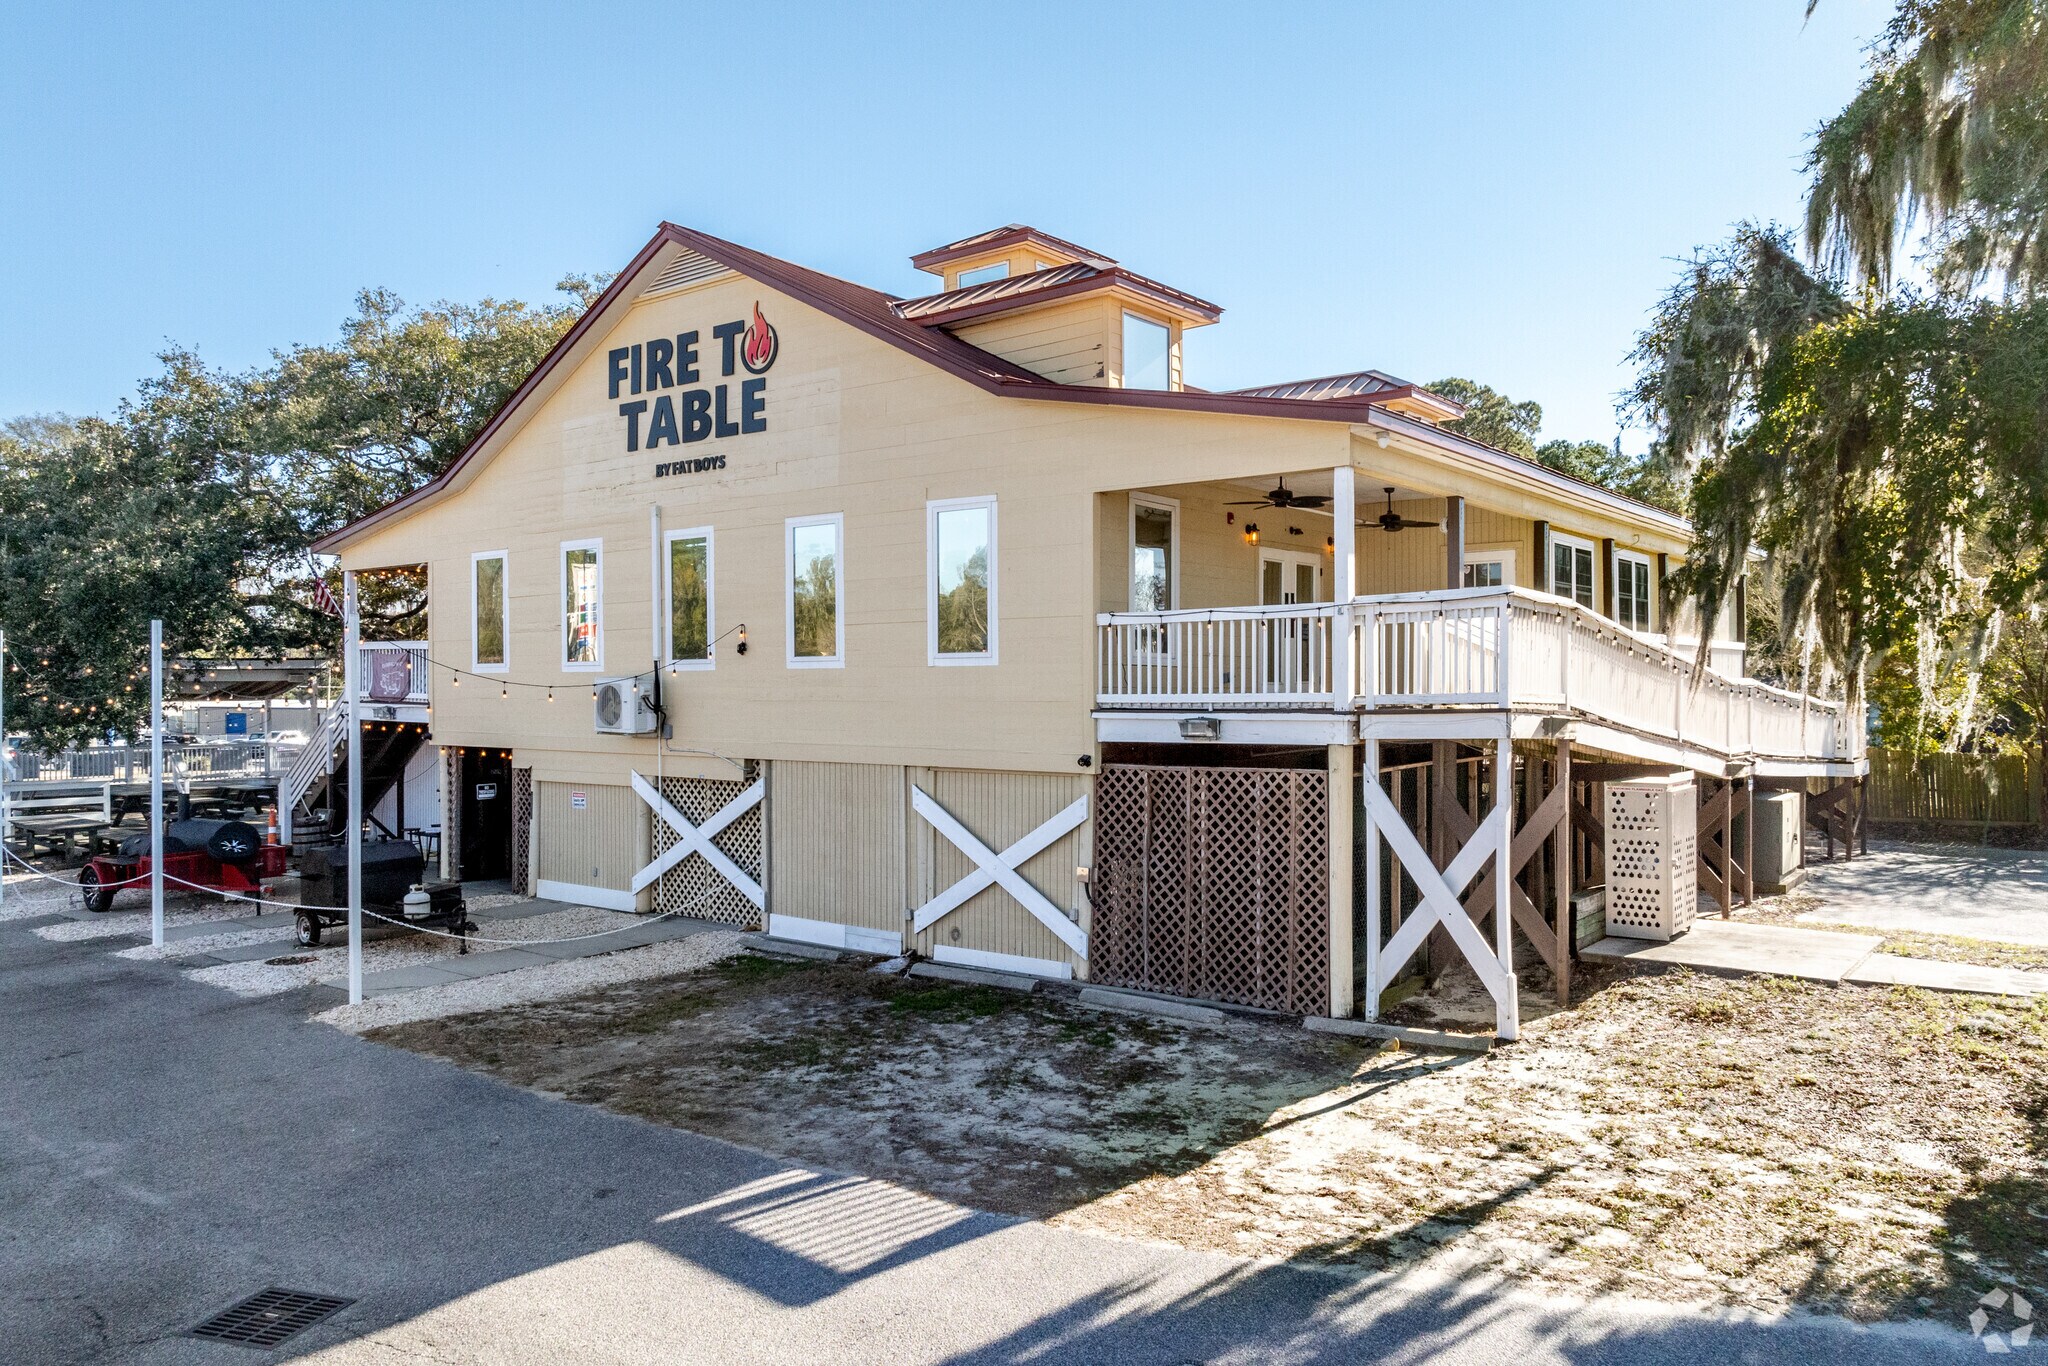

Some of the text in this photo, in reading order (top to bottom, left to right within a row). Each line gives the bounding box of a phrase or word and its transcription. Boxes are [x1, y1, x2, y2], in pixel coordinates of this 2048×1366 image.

[608, 300, 779, 400] FIRE TO
[619, 377, 767, 452] TABLE
